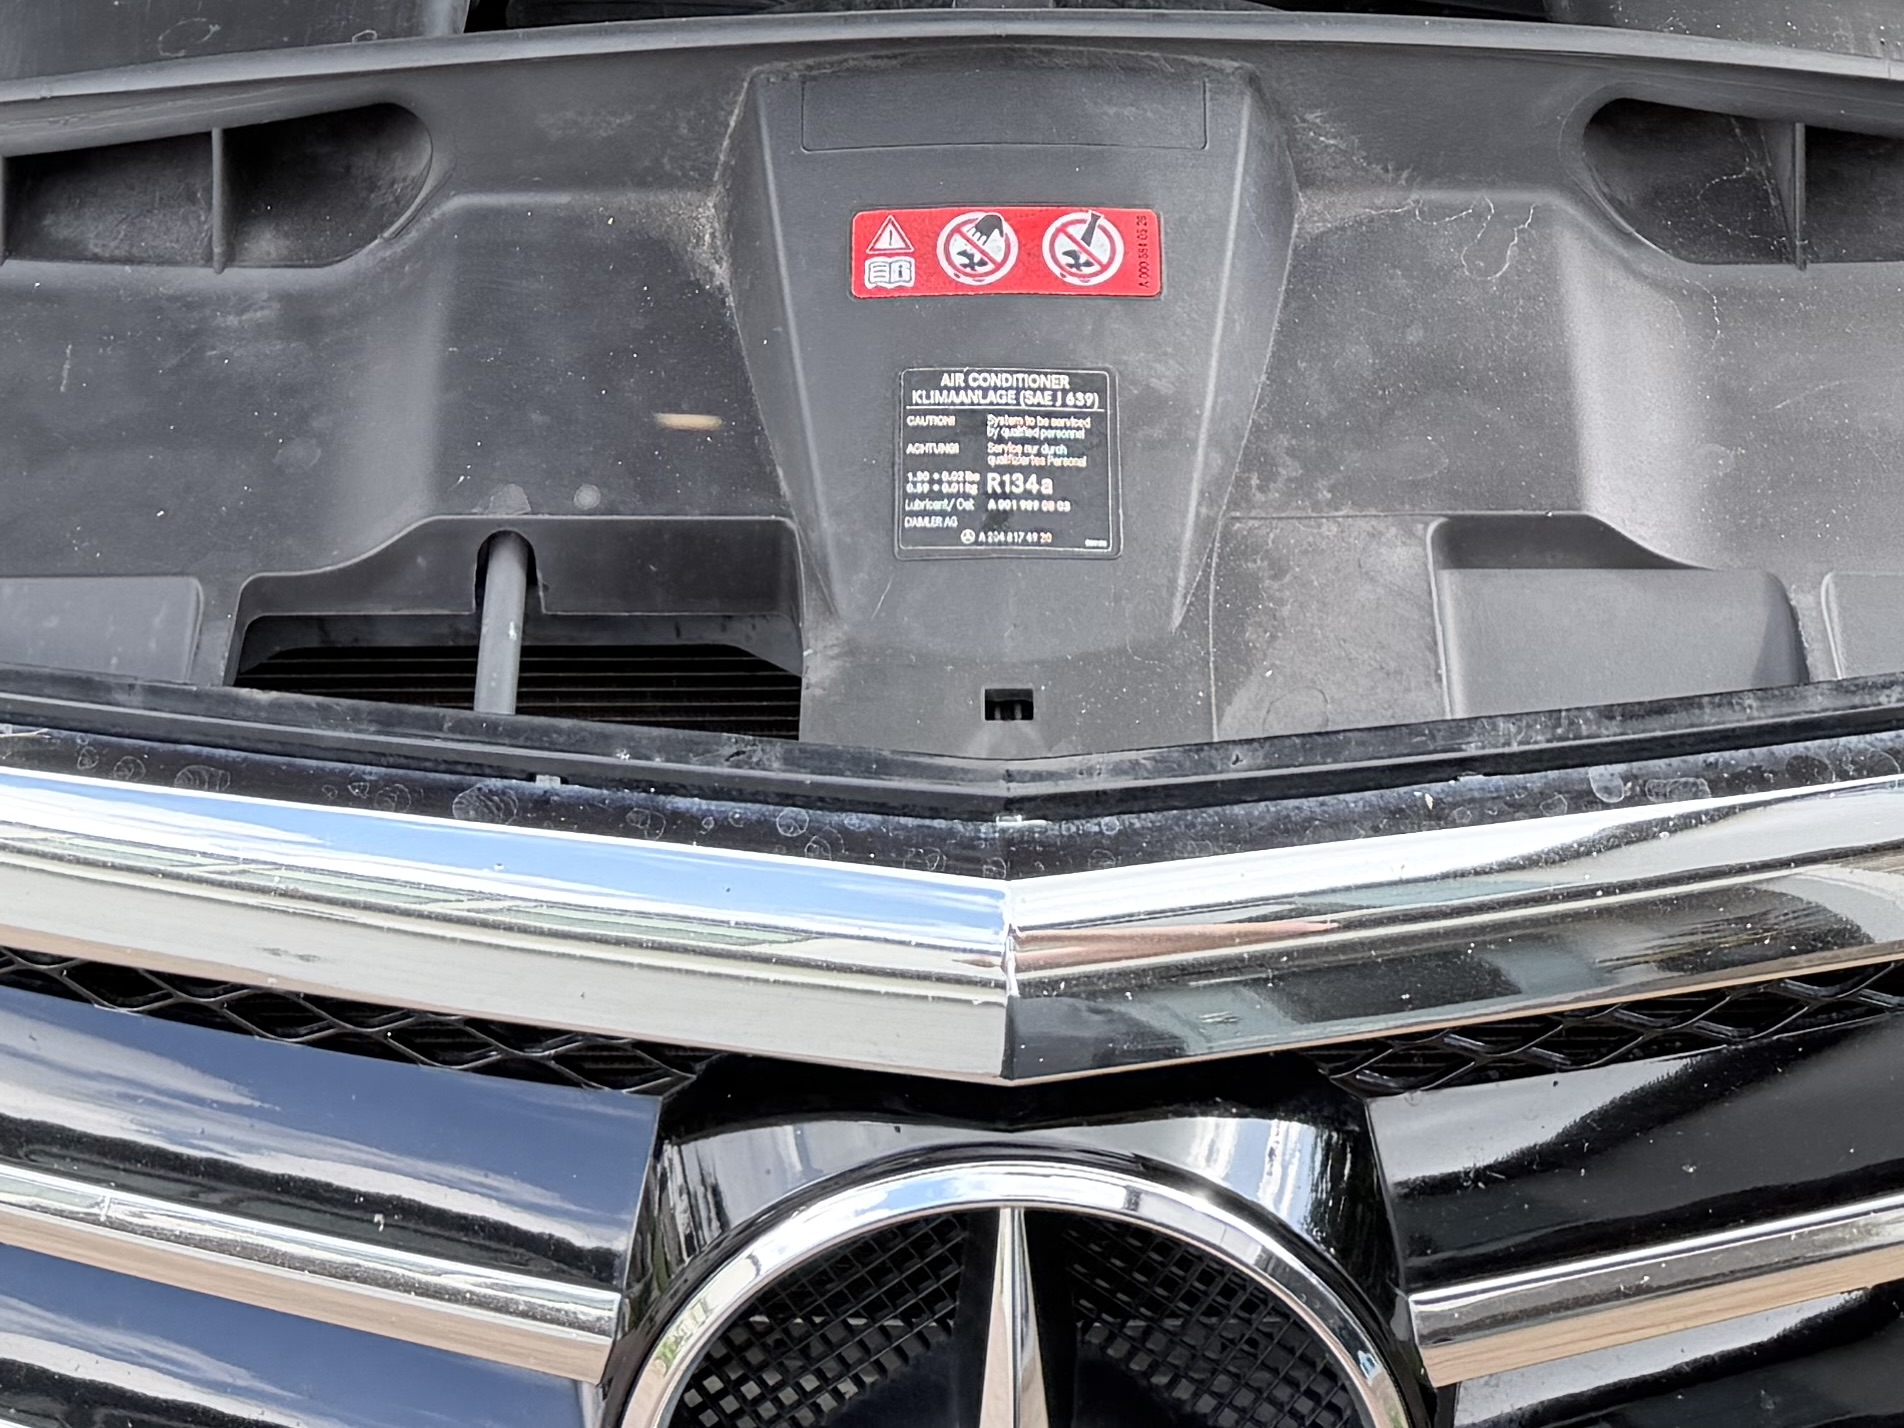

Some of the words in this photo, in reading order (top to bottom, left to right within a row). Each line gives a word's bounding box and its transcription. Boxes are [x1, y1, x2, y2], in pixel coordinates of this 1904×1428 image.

[940, 373, 965, 387] AIR
[968, 373, 1070, 389] CONDITIONER
[912, 390, 1016, 405] KLIMAANLAGE
[1020, 391, 1053, 408] (SAE
[1056, 393, 1062, 406] J
[1066, 393, 1099, 409] 639)
[987, 414, 1023, 428] System
[1025, 415, 1036, 426] to
[1037, 416, 1049, 426] be
[987, 426, 999, 440] by
[987, 472, 1053, 494] R134a
[987, 500, 996, 510] A
[904, 516, 943, 528] DAIMLER
[944, 516, 958, 528] AG
[978, 531, 986, 542] A
